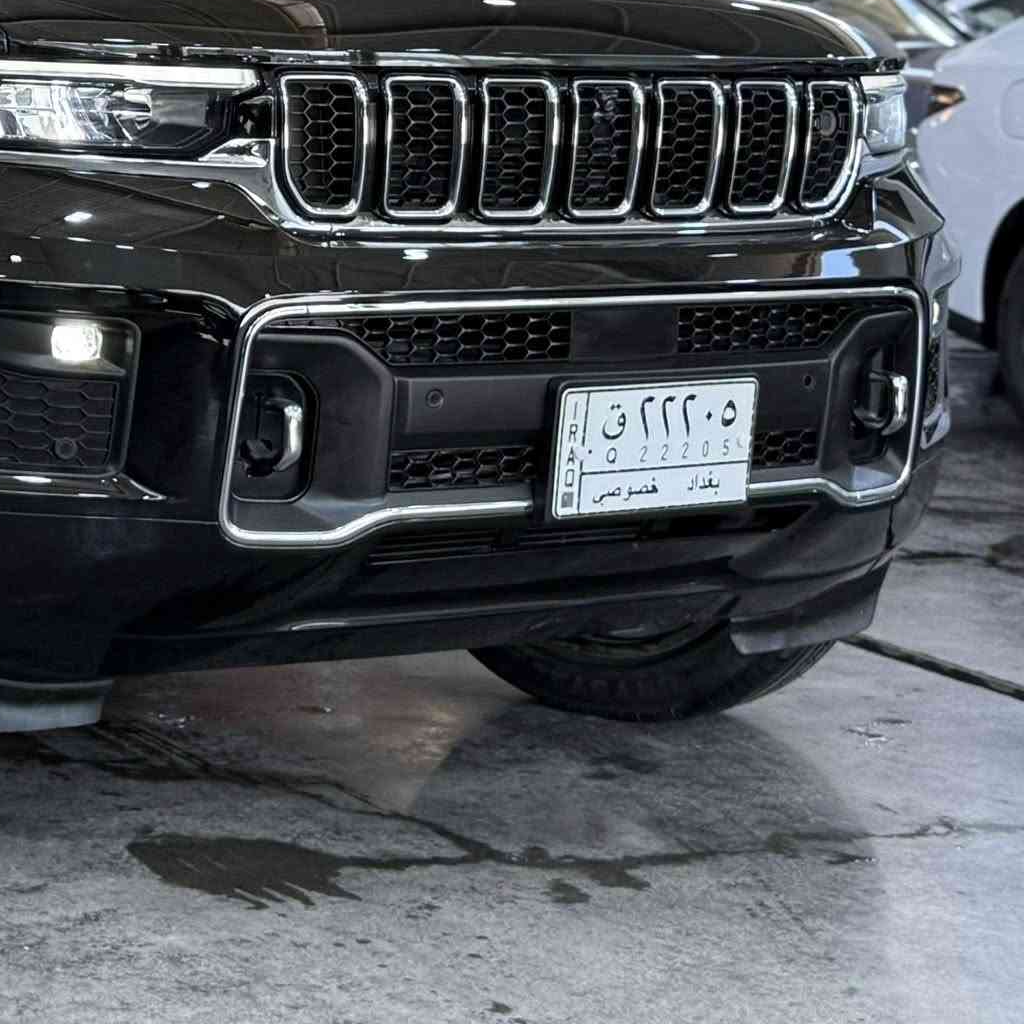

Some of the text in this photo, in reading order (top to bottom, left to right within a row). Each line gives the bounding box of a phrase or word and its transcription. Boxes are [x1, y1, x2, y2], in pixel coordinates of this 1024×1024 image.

[601, 404, 627, 440] ق
[564, 401, 578, 487] IRAQ
[606, 448, 617, 464] Q
[687, 471, 720, 495] بغداد
